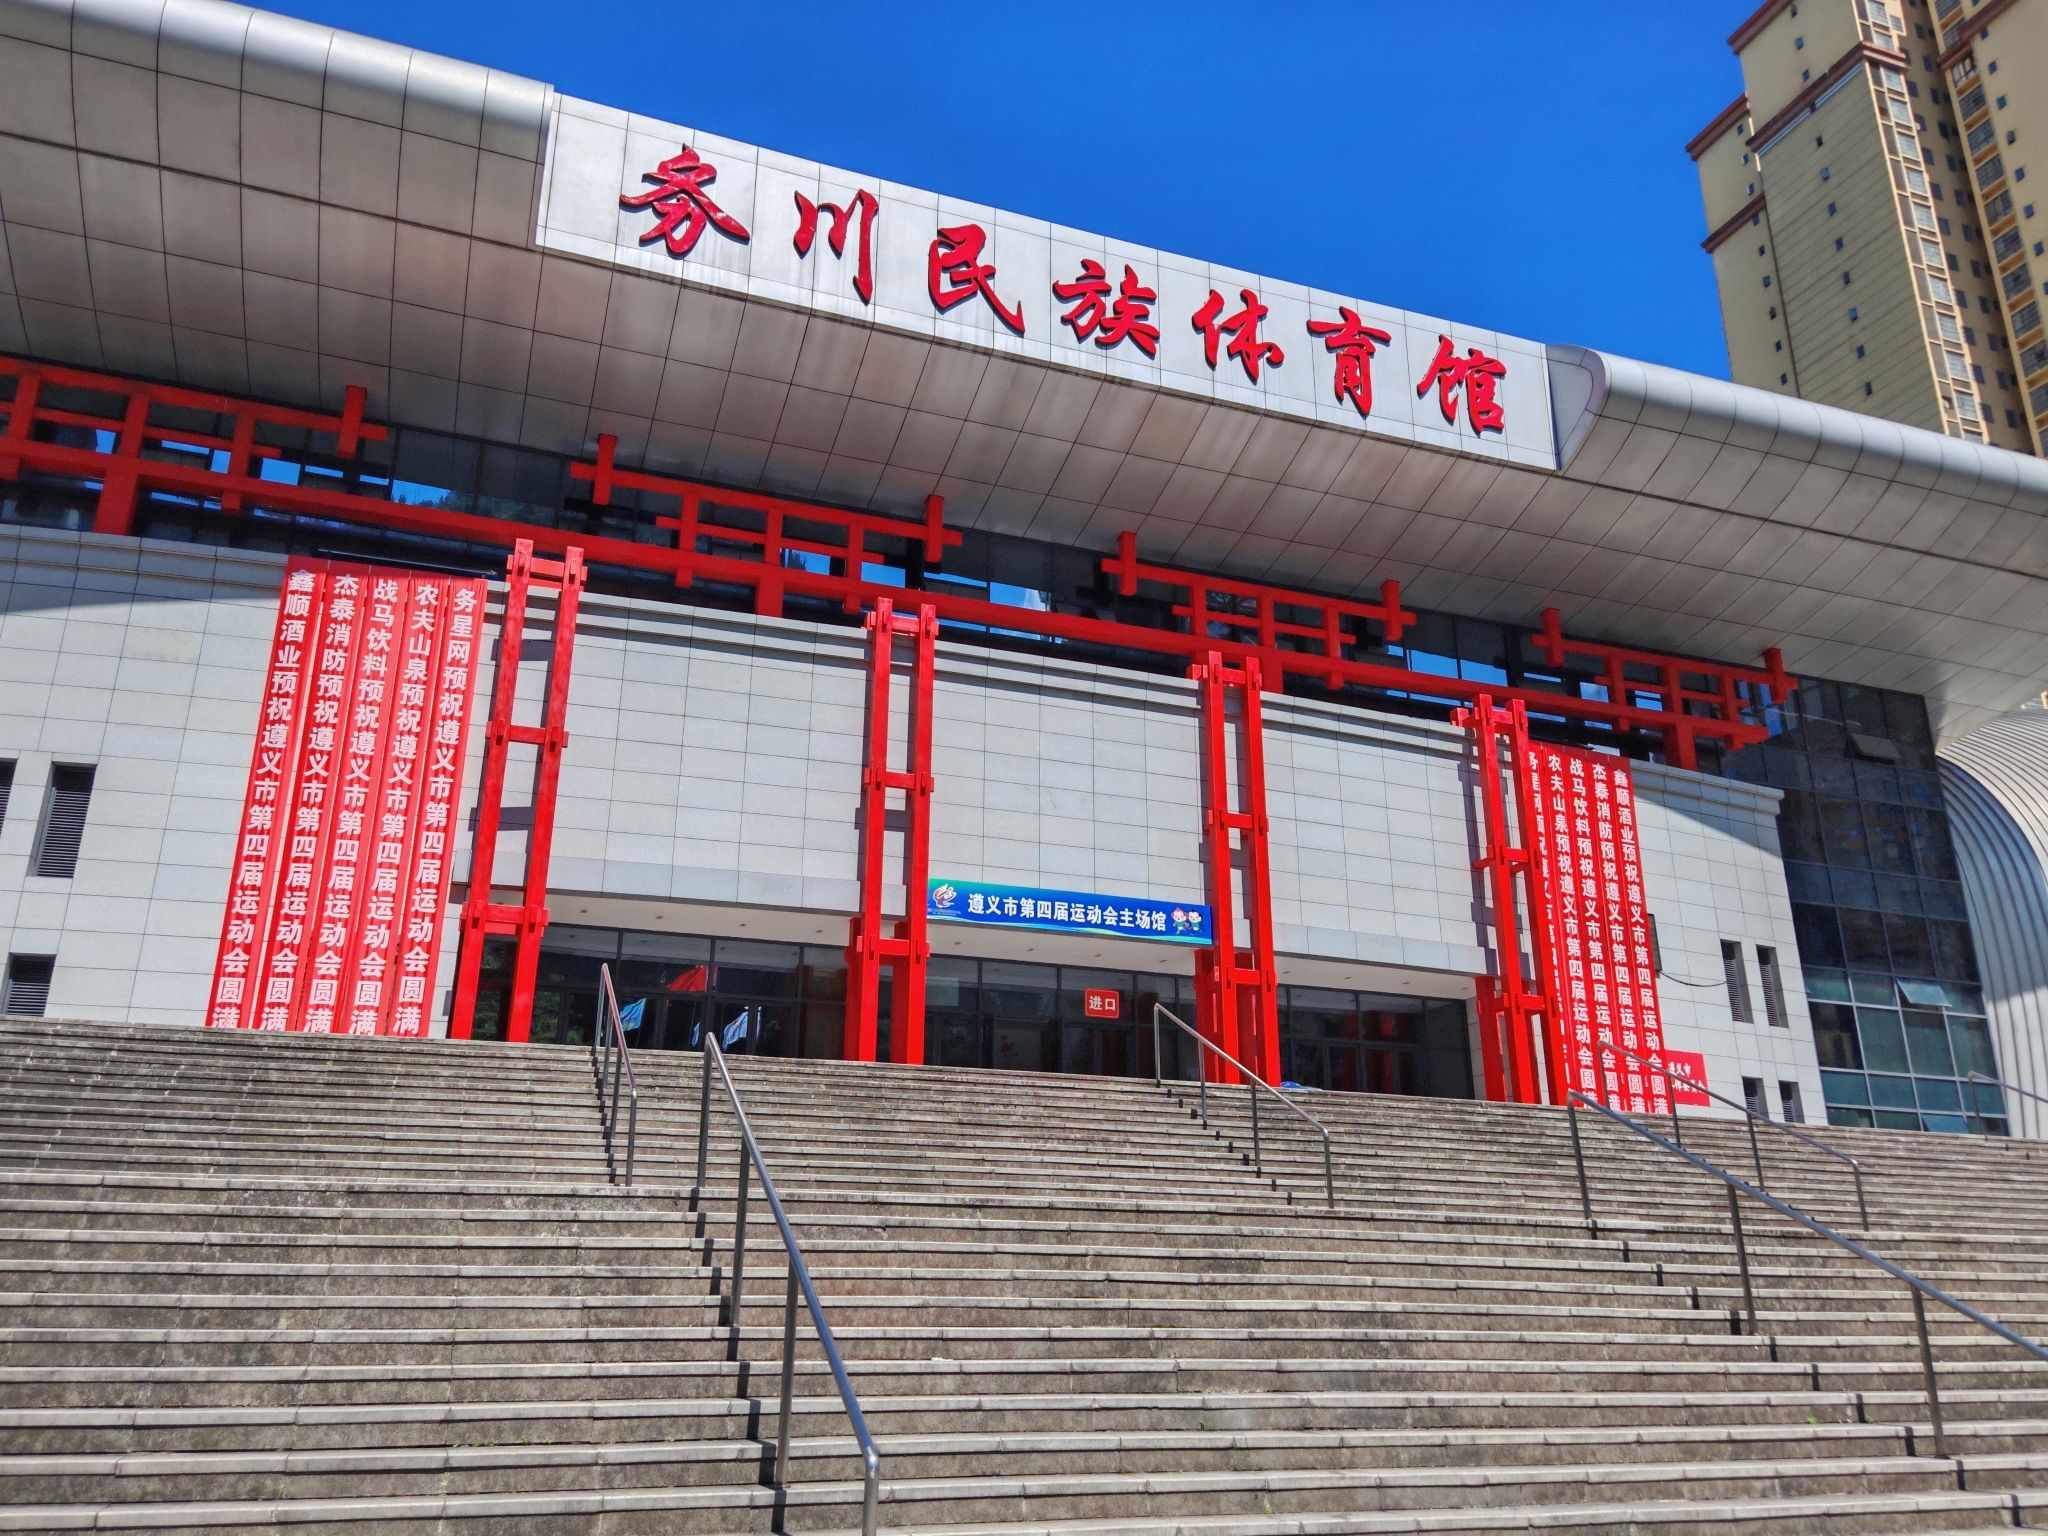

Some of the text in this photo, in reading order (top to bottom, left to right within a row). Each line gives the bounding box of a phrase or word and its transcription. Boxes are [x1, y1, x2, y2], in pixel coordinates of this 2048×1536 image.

[618, 143, 1507, 435] 务川民族体育馆
[211, 568, 315, 1028] 鑫顺酒业预祝遵义市第四届运动会圆满
[259, 573, 359, 1031] 杰泰消防预祝遵义市第四届运动会圆满
[303, 578, 399, 1034] 战马饮料预祝遵义市第四届运动会圆满
[348, 584, 439, 1035] 农夫山泉预祝遵义市第四届运动会圆满
[392, 588, 478, 1035] 务星网预祝遵义市第四届运动会圆满
[967, 892, 1167, 932] 遵义市第四届运动会主场馆
[1088, 995, 1116, 1011] 进口
